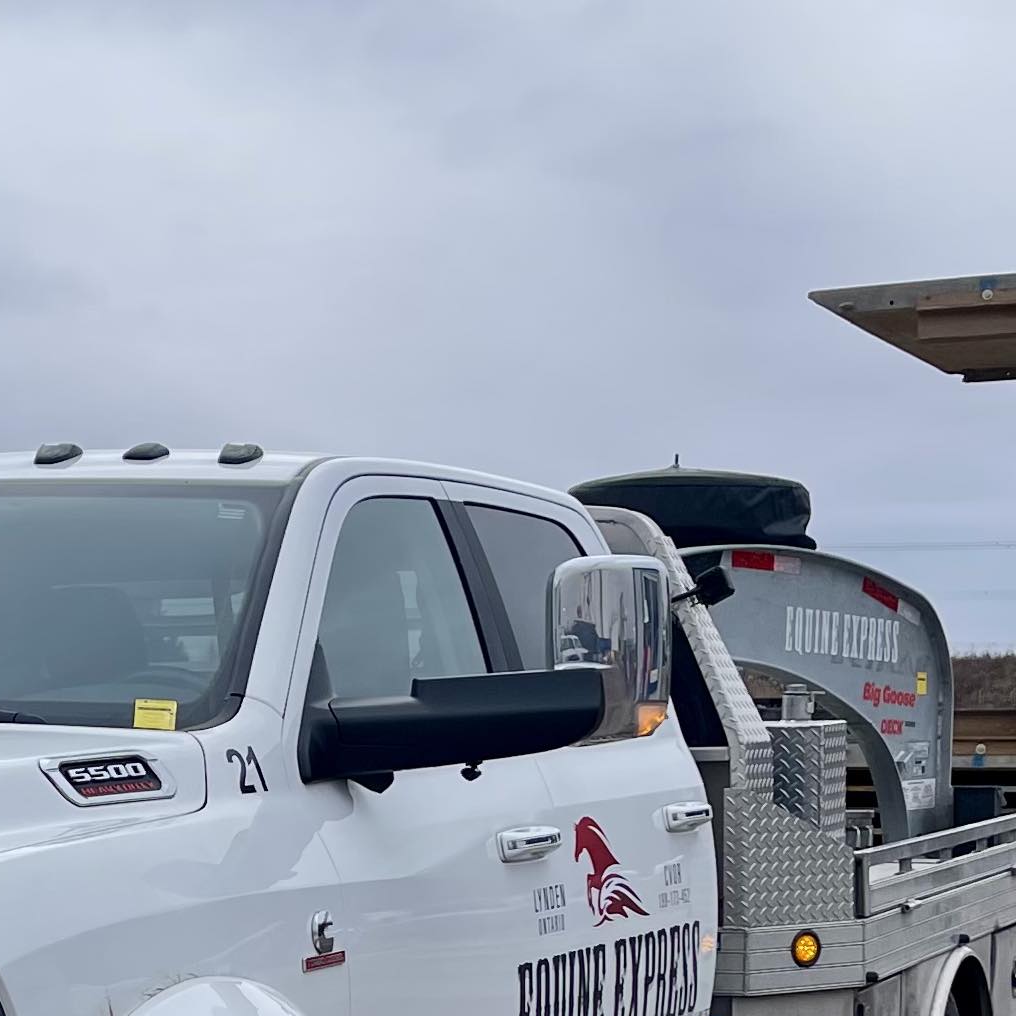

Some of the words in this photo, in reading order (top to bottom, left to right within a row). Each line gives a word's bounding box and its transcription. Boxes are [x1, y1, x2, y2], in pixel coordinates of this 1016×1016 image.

[785, 606, 840, 655] EQUINE
[842, 614, 900, 663] EXPRESS
[863, 682, 882, 707] Big
[883, 685, 916, 707] Goose
[68, 763, 146, 782] 5500
[226, 746, 269, 794] 21
[533, 884, 566, 912] LYNDEN
